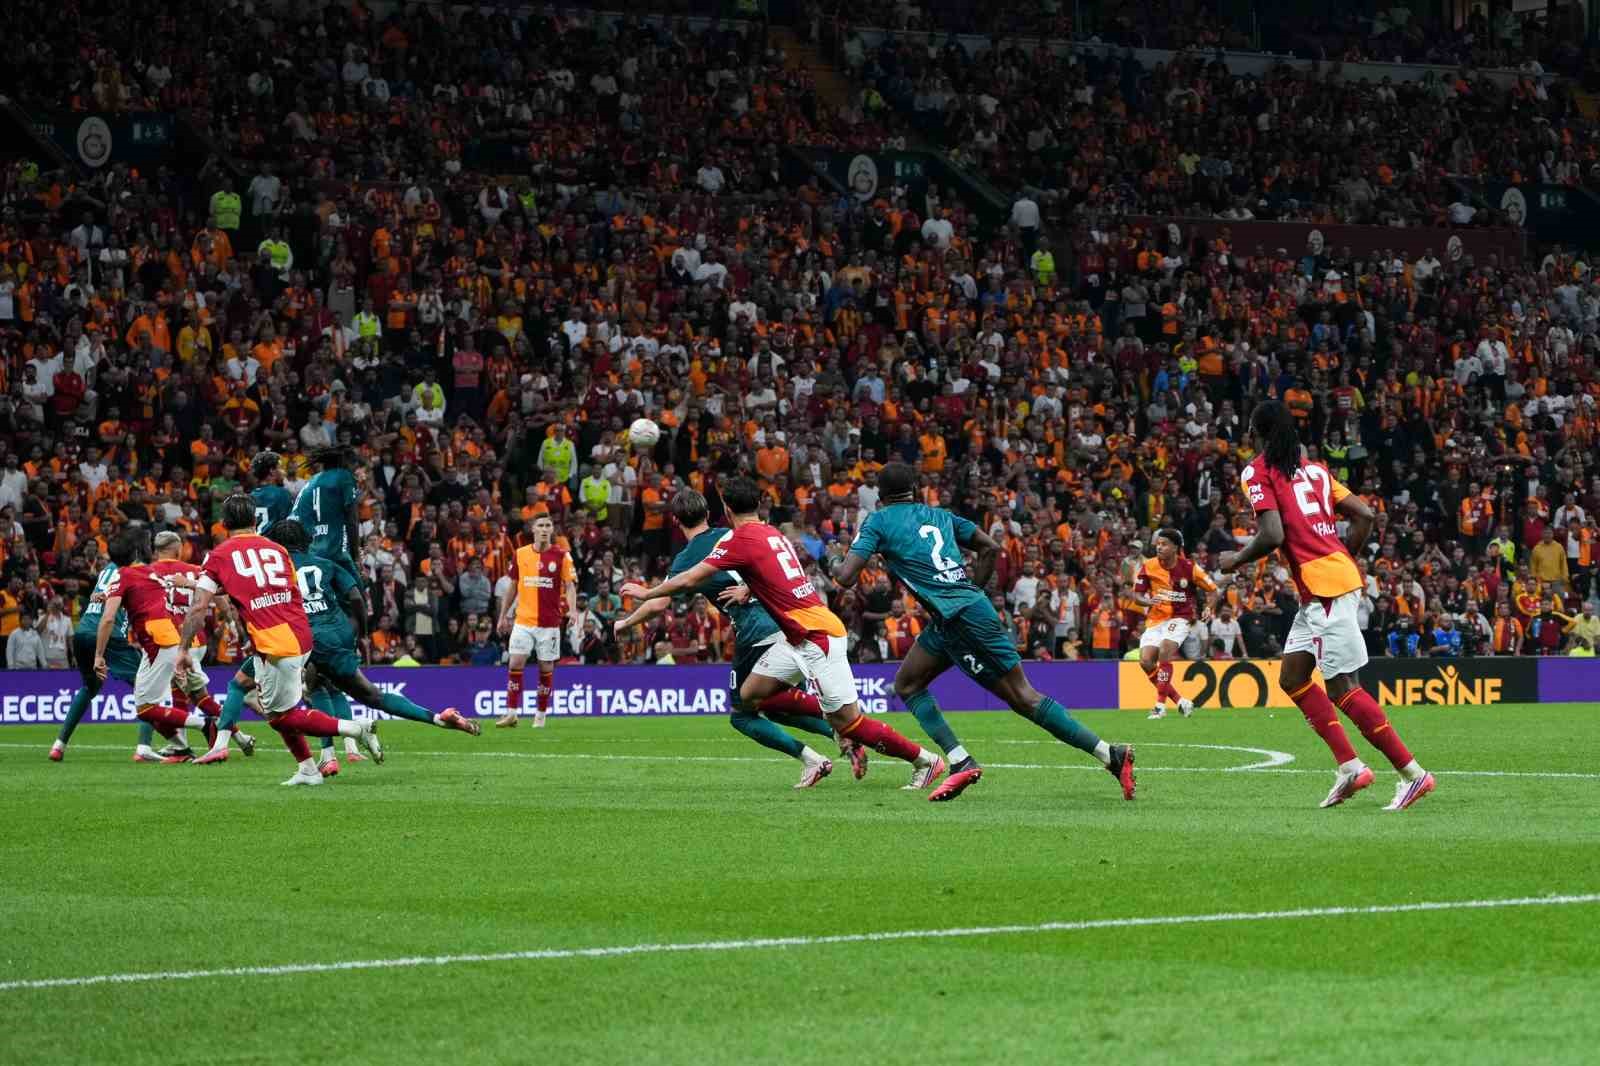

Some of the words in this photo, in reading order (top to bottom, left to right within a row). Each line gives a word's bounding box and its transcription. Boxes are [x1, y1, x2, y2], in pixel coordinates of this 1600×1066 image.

[1293, 464, 1331, 516] 27
[231, 548, 289, 588] 42
[918, 525, 959, 571] 2
[963, 654, 984, 674] 2
[1183, 661, 1269, 708] 20
[474, 683, 593, 715] GEEEĞİ
[596, 688, 727, 713] TASARLAR
